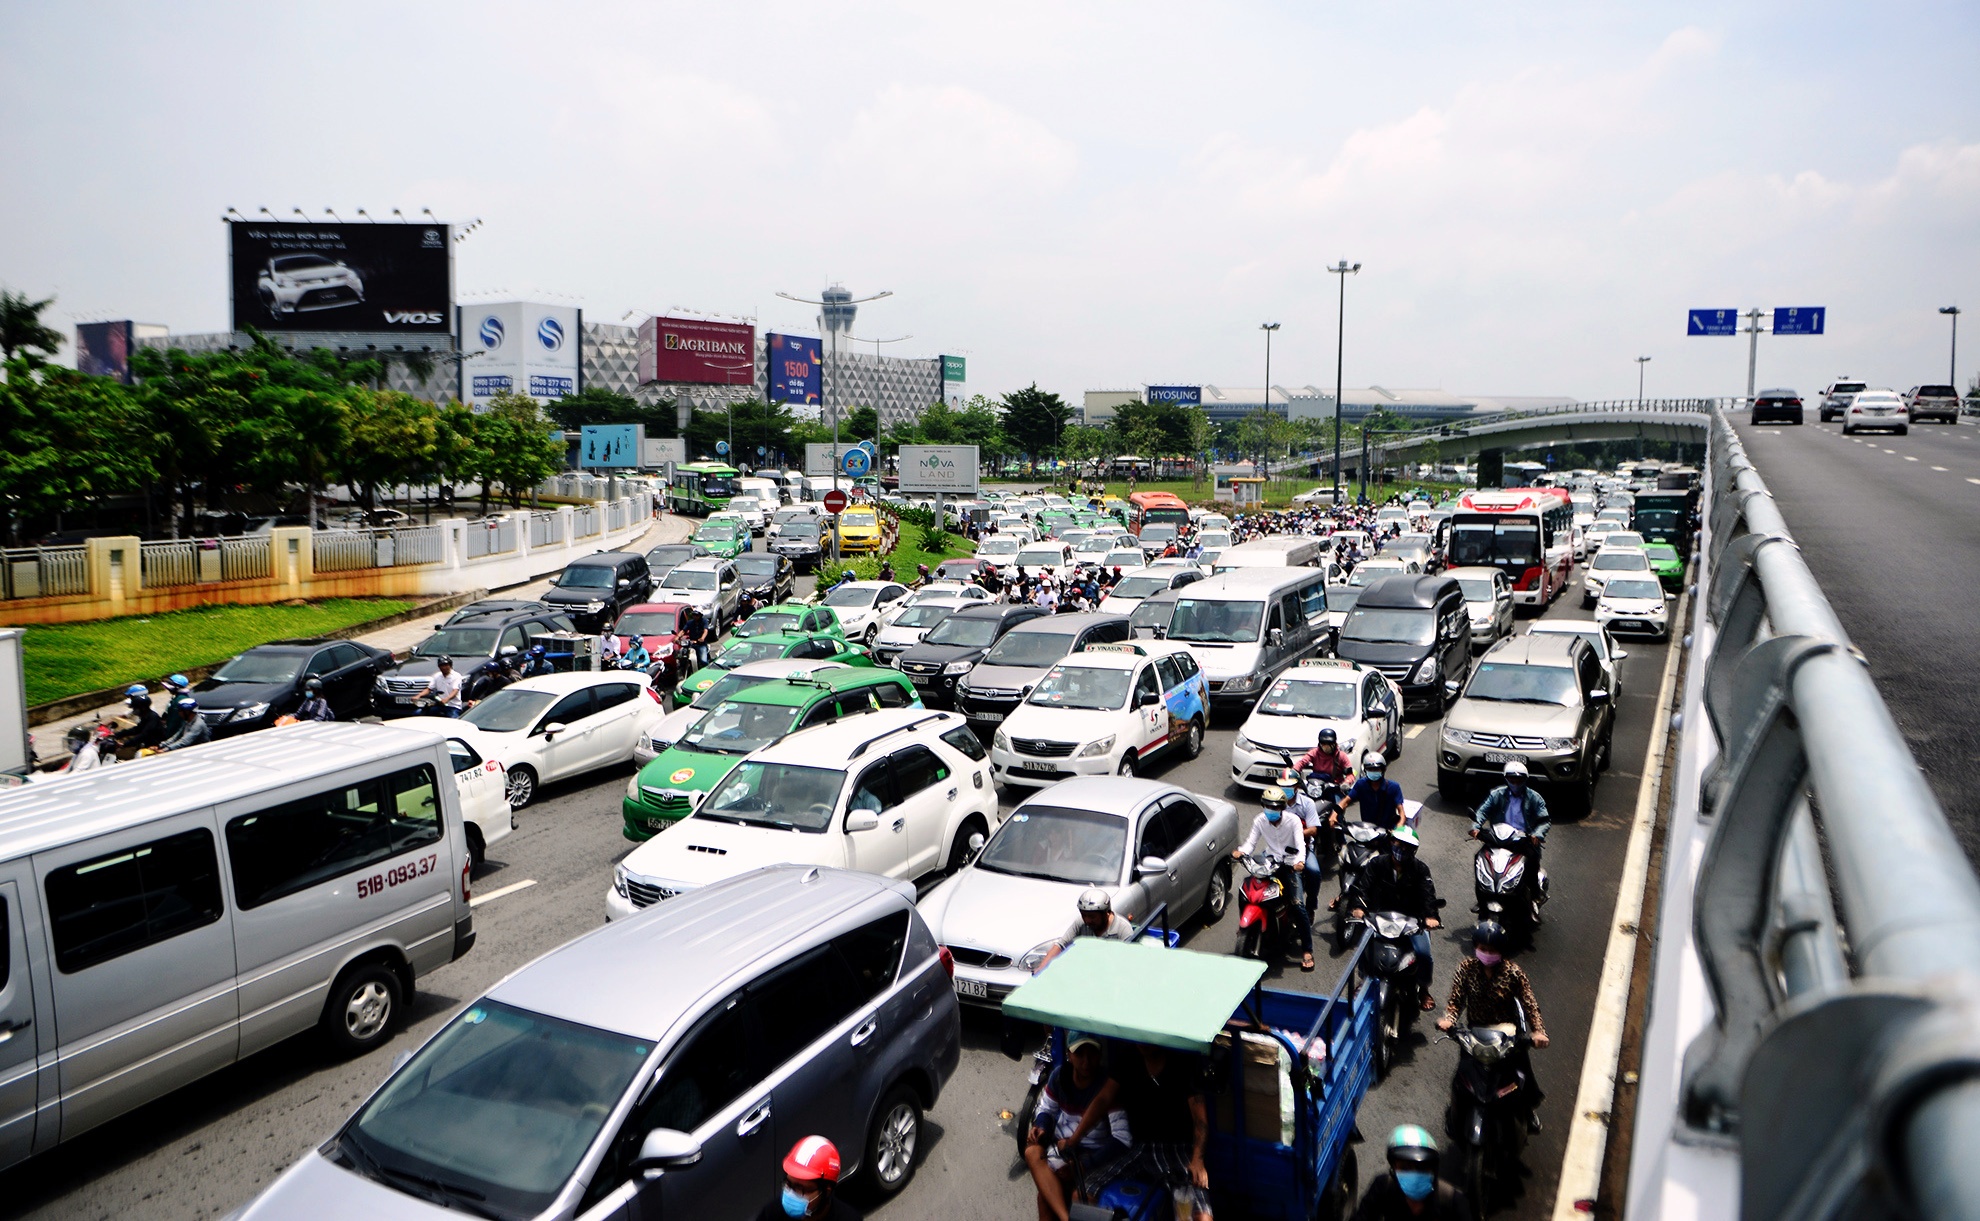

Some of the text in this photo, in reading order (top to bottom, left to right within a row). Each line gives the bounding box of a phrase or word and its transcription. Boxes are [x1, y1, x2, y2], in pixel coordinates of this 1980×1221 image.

[383, 311, 443, 324] VIOS
[680, 339, 746, 355] AGRIBANK
[785, 361, 809, 378] 1500
[548, 379, 559, 387] 277
[531, 387, 547, 395] 0918
[1151, 390, 1197, 400] HYOSUNG
[920, 470, 955, 478] LAND
